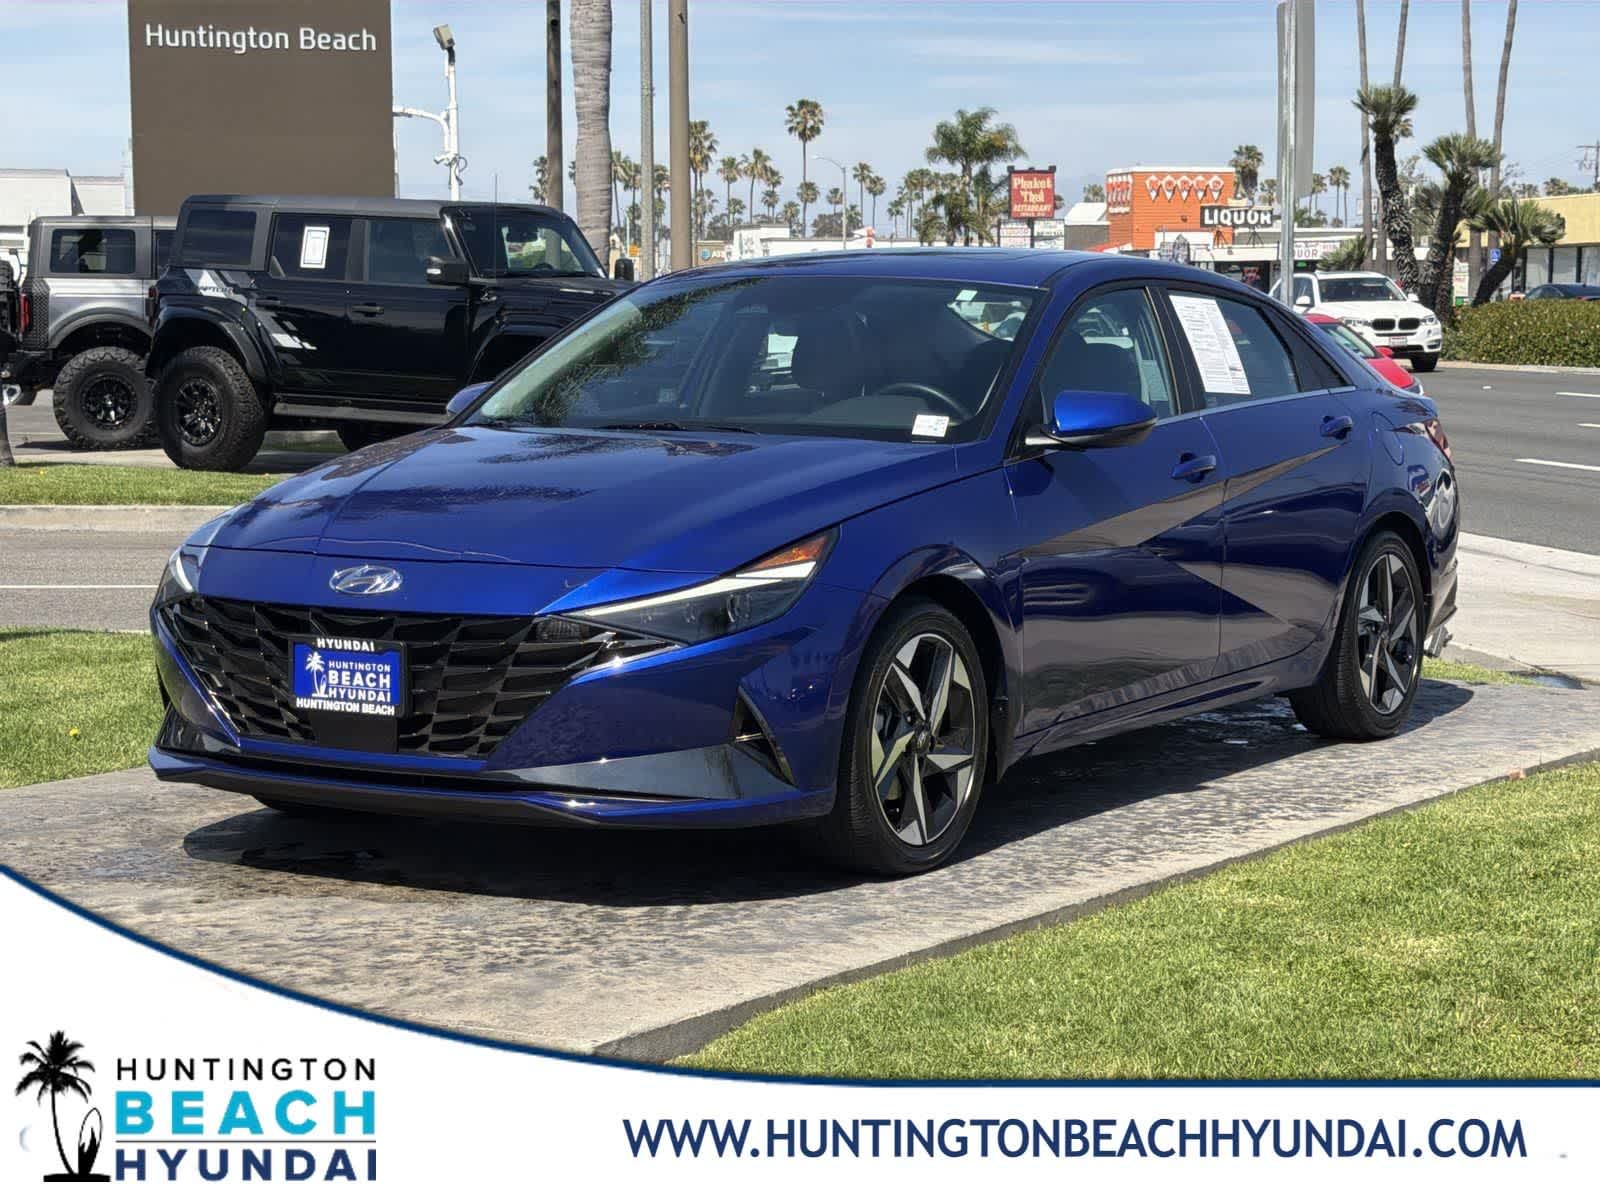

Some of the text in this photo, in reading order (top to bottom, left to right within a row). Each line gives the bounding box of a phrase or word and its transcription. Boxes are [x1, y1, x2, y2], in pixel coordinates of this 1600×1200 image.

[145, 23, 377, 54] Huntington Beach
[1203, 208, 1272, 226] LIQUOR
[316, 638, 375, 652] HYUNDAI
[328, 660, 391, 673] HUNTINGTON
[328, 670, 391, 689] BEACH
[328, 687, 391, 703] HYUNDAI
[296, 697, 395, 716] HUNTINGTON BEACH
